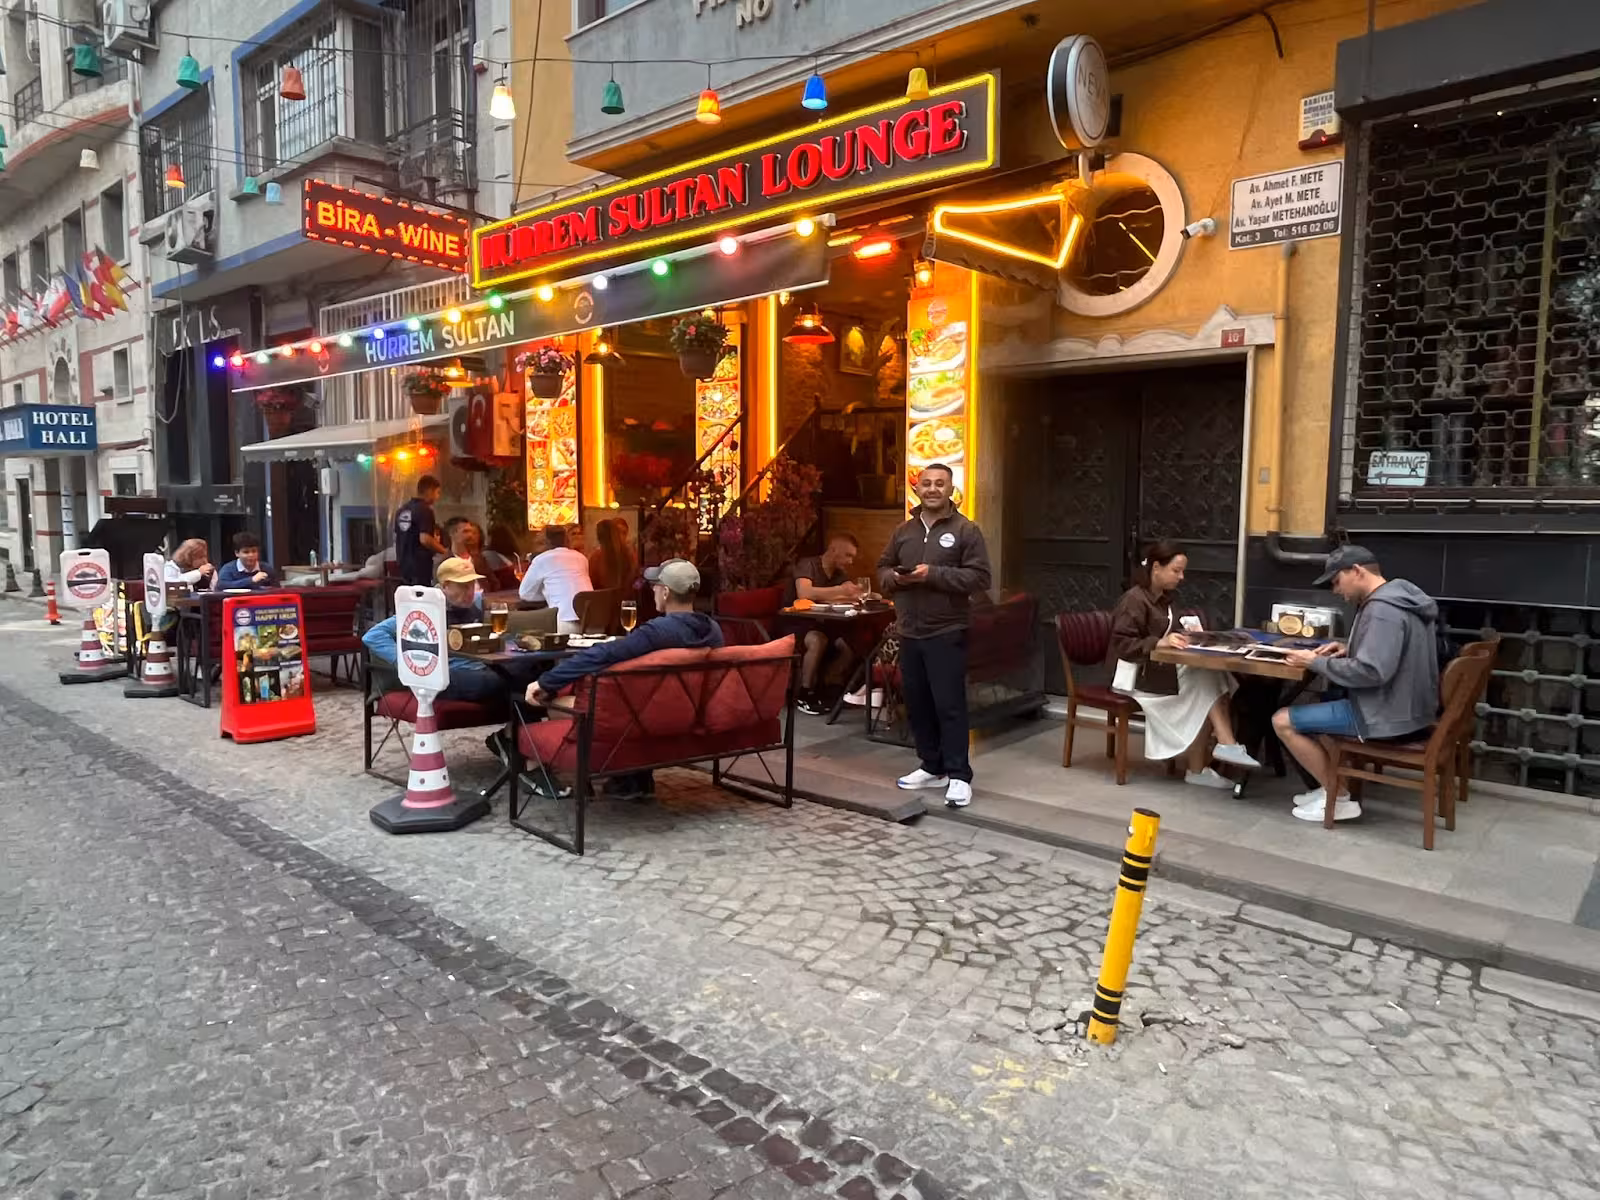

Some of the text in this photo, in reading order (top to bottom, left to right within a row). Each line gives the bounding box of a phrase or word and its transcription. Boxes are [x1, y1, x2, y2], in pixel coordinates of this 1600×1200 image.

[608, 162, 749, 236] SULTAN
[761, 100, 968, 199] LOUNGE
[1249, 170, 1324, 194] Av. Ahmet F. METE
[1251, 198, 1263, 210] Av.
[1284, 192, 1295, 204] M.
[1296, 187, 1321, 203] METE
[1234, 215, 1246, 229] Av.
[1271, 200, 1337, 222] METEHANOĞLU
[1254, 231, 1261, 241] 3
[1309, 222, 1321, 233] 02
[441, 310, 515, 349] SULTAN
[1227, 332, 1240, 343] 10
[32, 411, 93, 426] HOTEL
[41, 430, 88, 444] HALI
[1371, 454, 1426, 469] ENTRANCE
